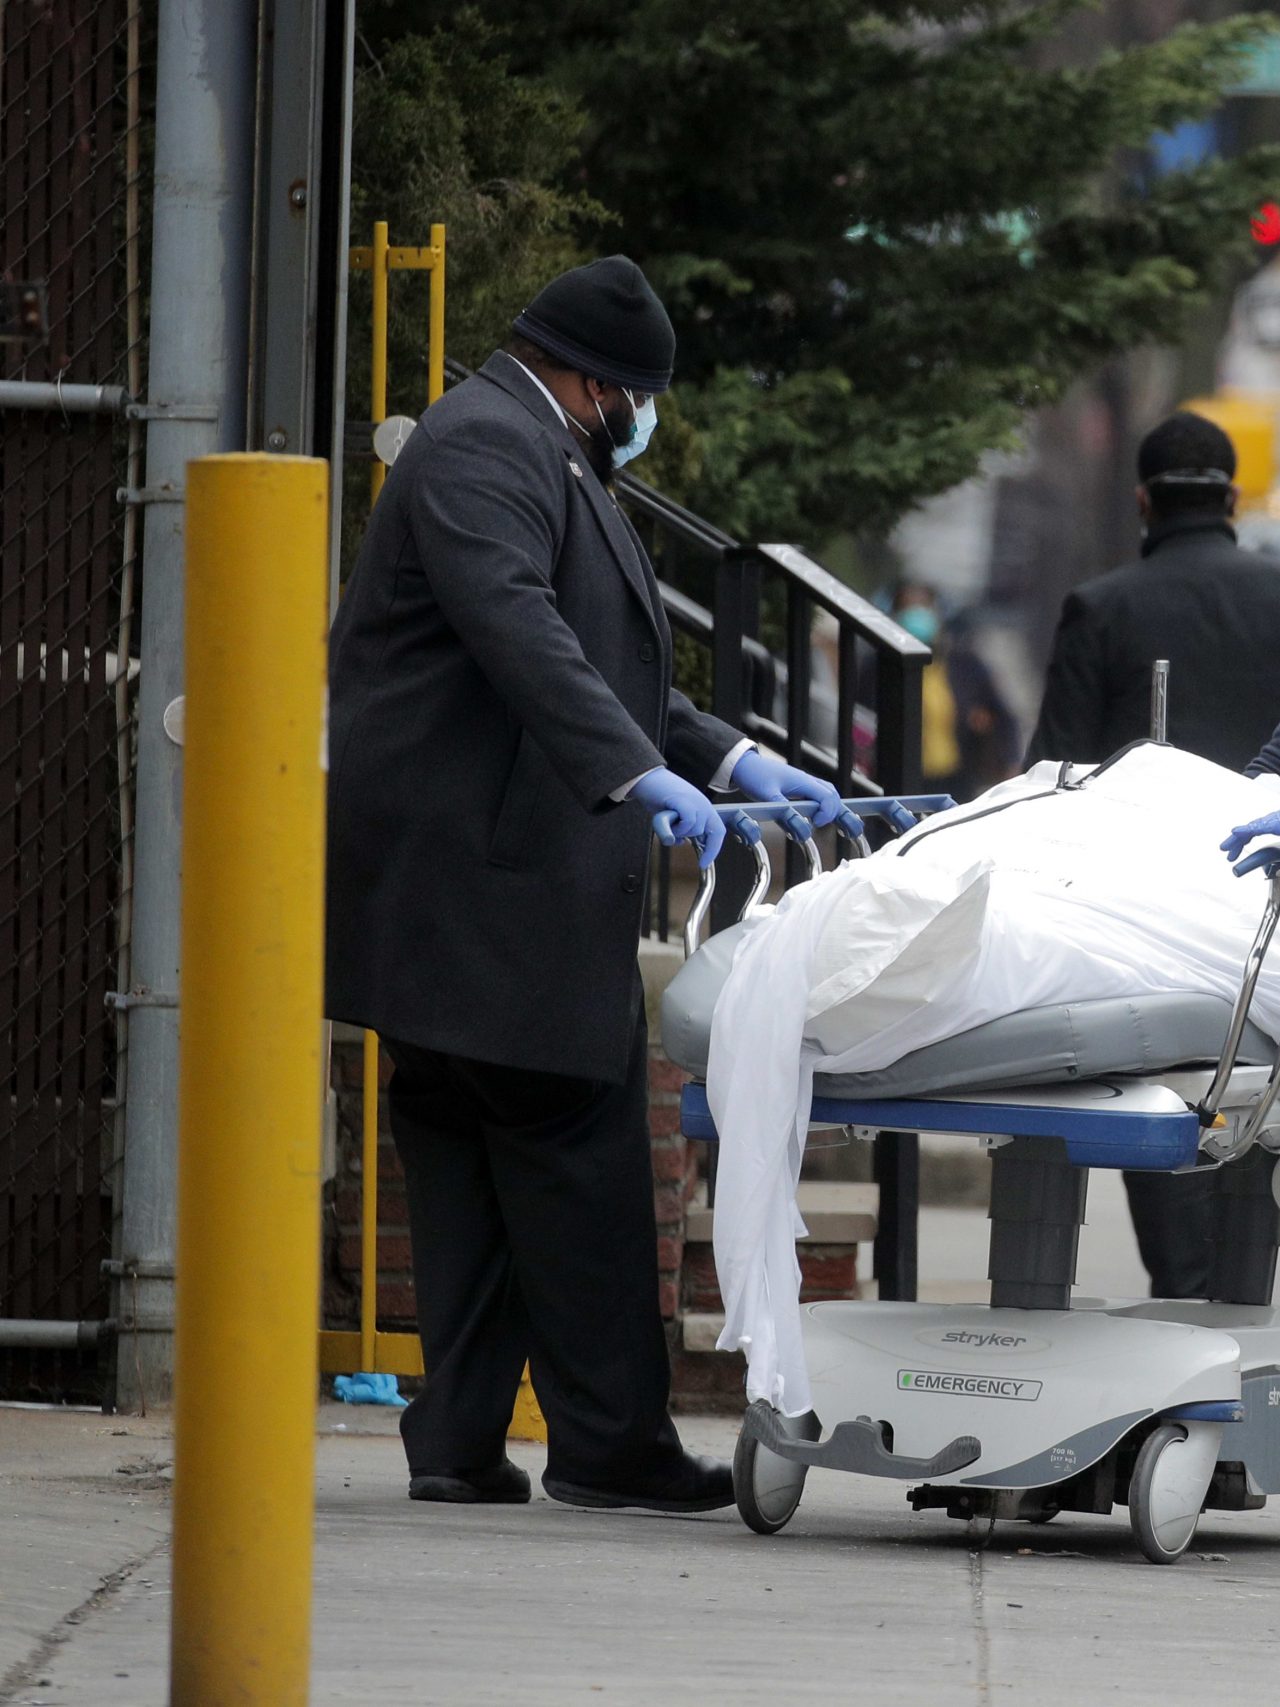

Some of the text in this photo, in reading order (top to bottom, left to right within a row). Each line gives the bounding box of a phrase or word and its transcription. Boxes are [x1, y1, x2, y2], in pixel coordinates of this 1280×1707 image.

[941, 1331, 1027, 1347] stryker
[914, 1374, 1024, 1396] EMERGENCY
[1052, 1447, 1066, 1455] 700
